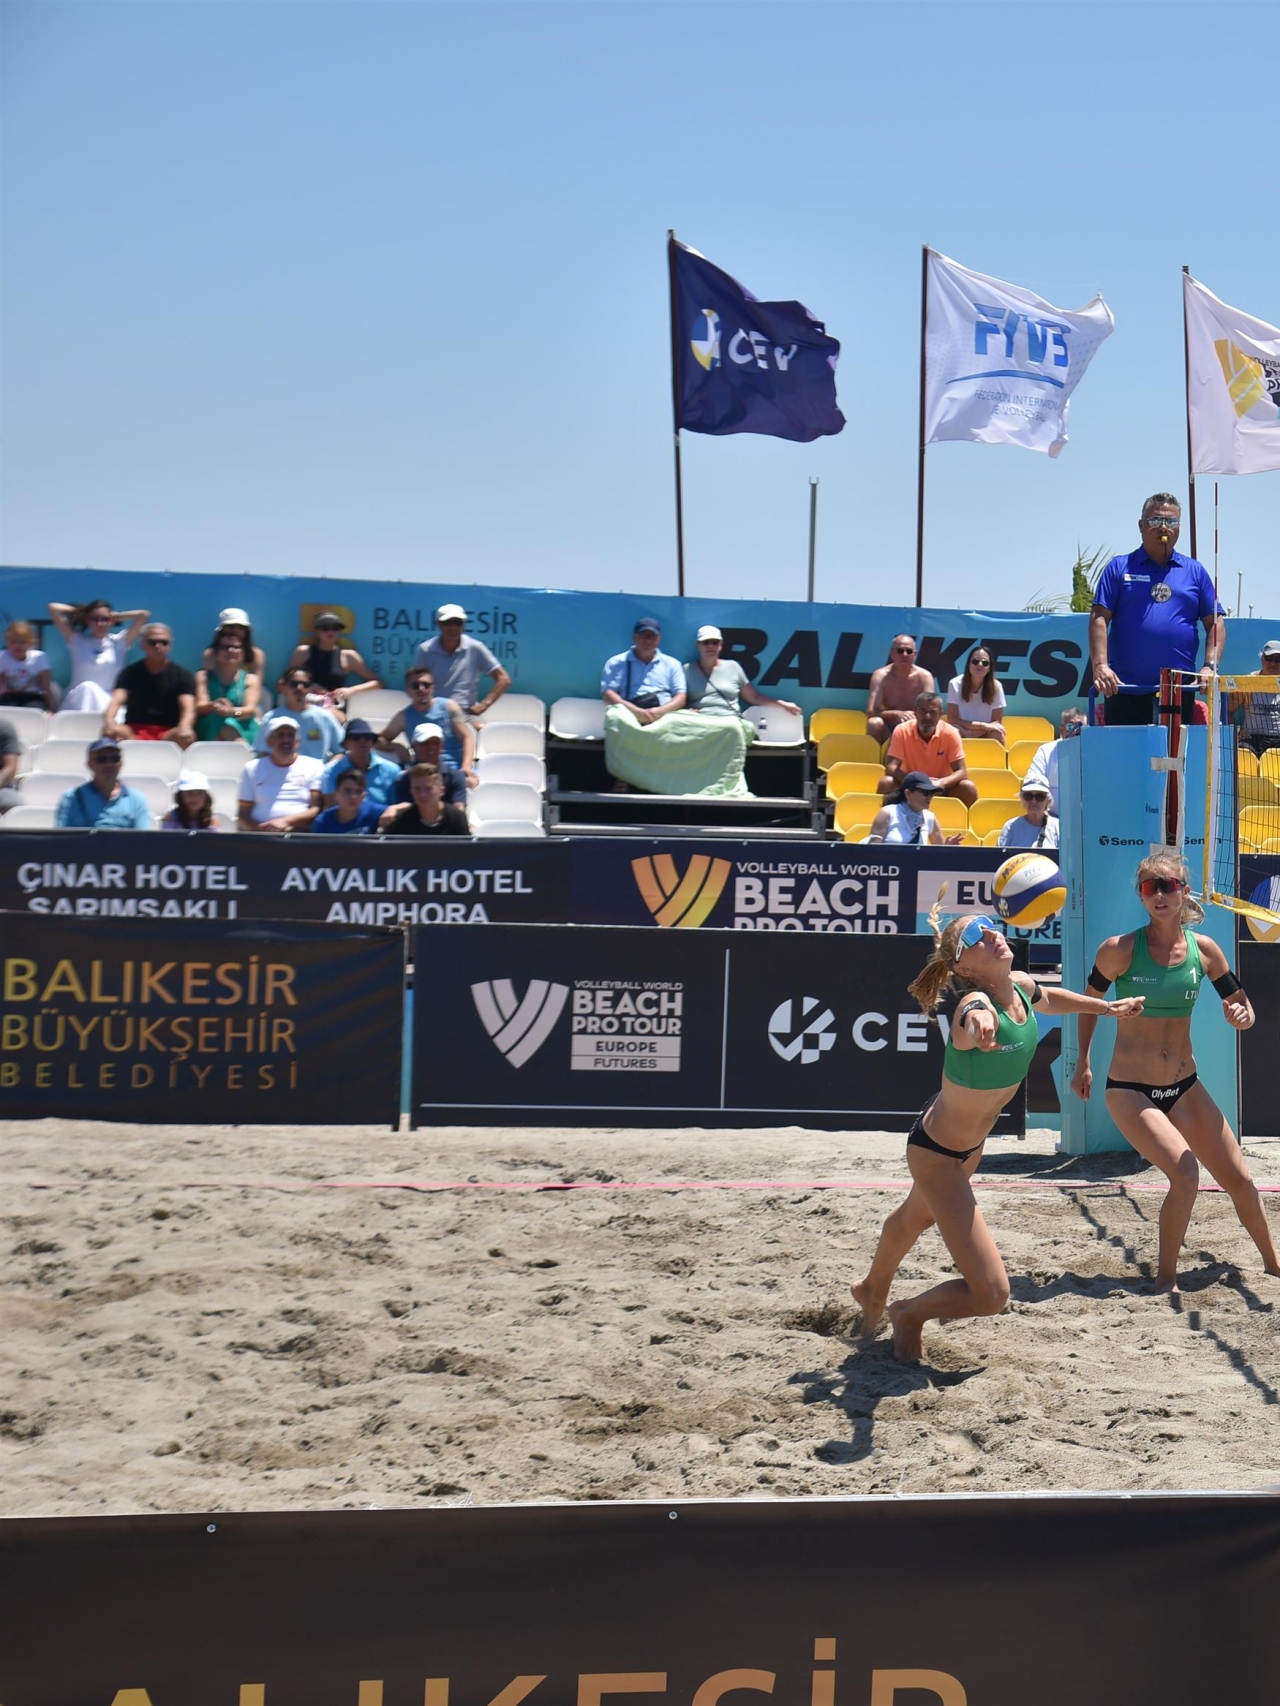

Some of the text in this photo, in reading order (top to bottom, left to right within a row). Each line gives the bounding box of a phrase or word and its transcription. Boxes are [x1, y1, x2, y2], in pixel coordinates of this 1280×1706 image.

[728, 328, 798, 371] CEV
[373, 607, 518, 634] BALIESİR
[373, 635, 519, 659] BÜYHİR
[17, 862, 249, 894] ÇINAR HOTEL
[280, 867, 534, 894] AYVALIK HOTEL
[736, 861, 900, 877] VOLLEYBALL WORLD
[734, 876, 900, 916] BEACH
[325, 901, 490, 926] AMPHORA
[1, 956, 299, 1006] BALIKESİR
[574, 980, 683, 990] VOLLEYBALL WORLD
[1189, 967, 1197, 984] 1
[572, 990, 683, 1016] BEACH
[1, 1008, 297, 1061] BÜYÜKŞEHİR
[571, 1016, 682, 1035] PRO TOUR
[595, 1041, 658, 1053] EUROPE
[0, 1060, 298, 1090] BELEDİYESİ
[593, 1058, 658, 1069] FUTURES
[1151, 1087, 1180, 1101] OlyBet
